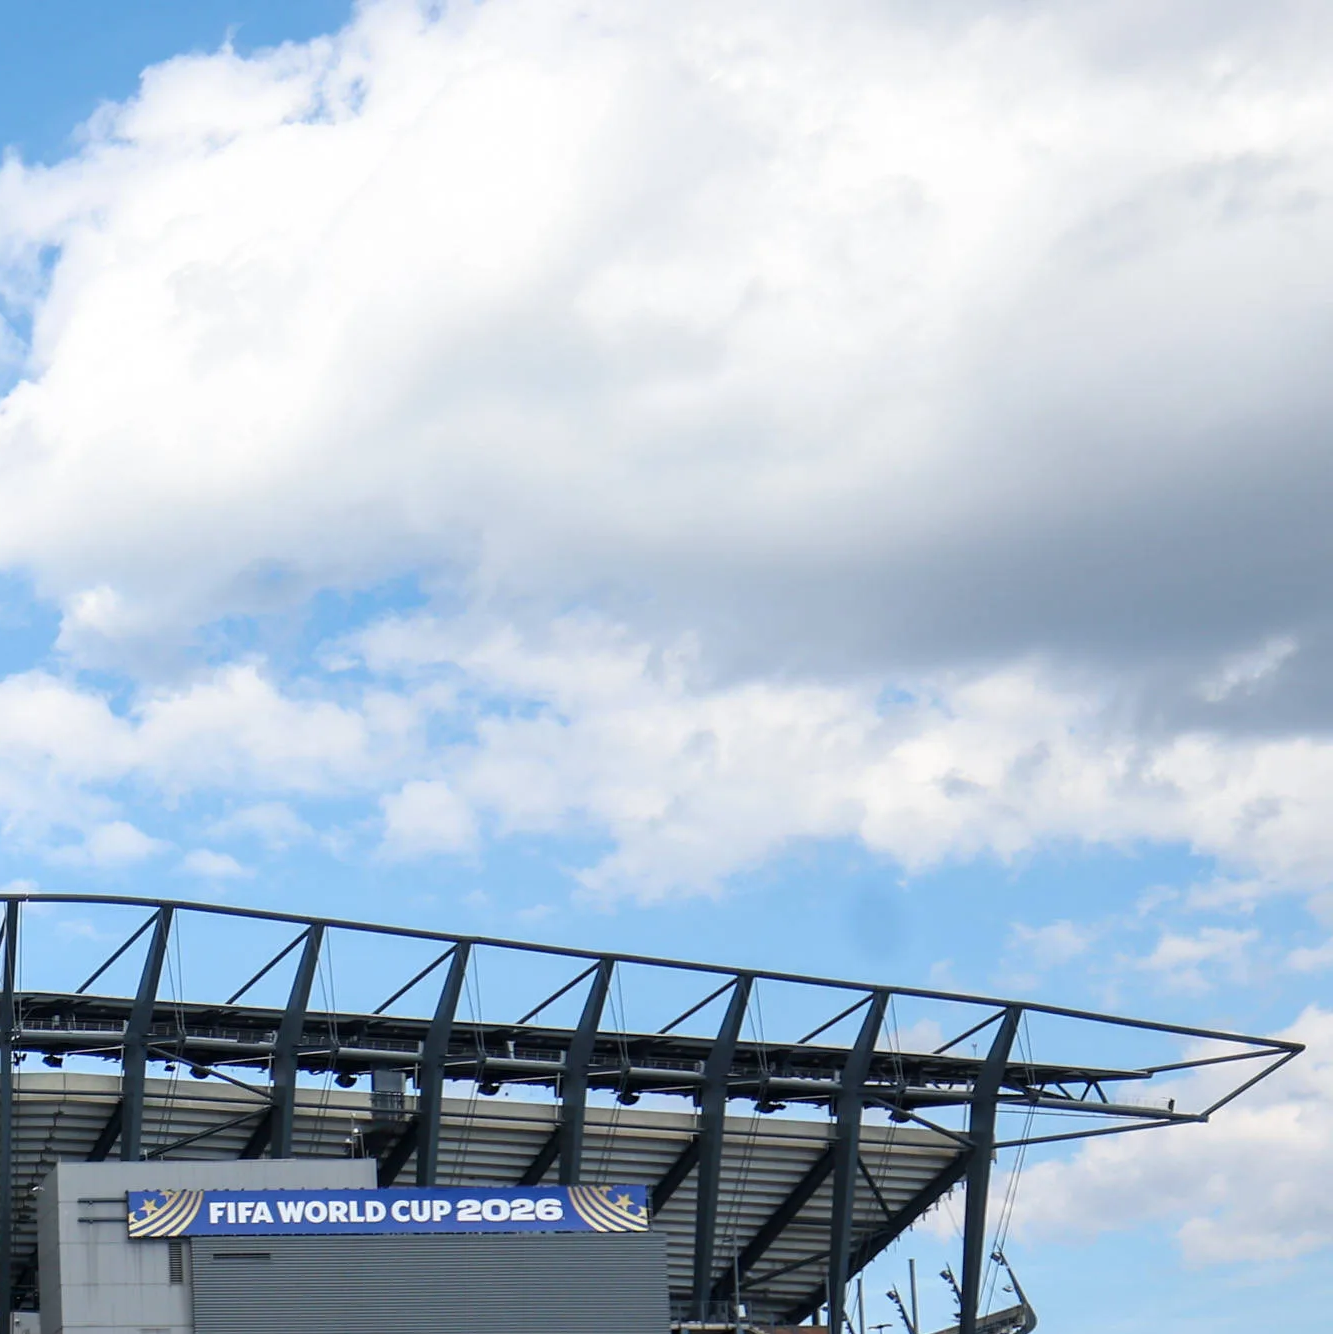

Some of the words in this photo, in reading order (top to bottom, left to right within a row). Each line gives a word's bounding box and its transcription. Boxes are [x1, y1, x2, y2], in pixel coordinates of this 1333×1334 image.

[209, 1201, 274, 1224] FIFA
[277, 1200, 387, 1224] WORLD
[391, 1199, 452, 1223] CUP
[456, 1198, 563, 1222] 2026
